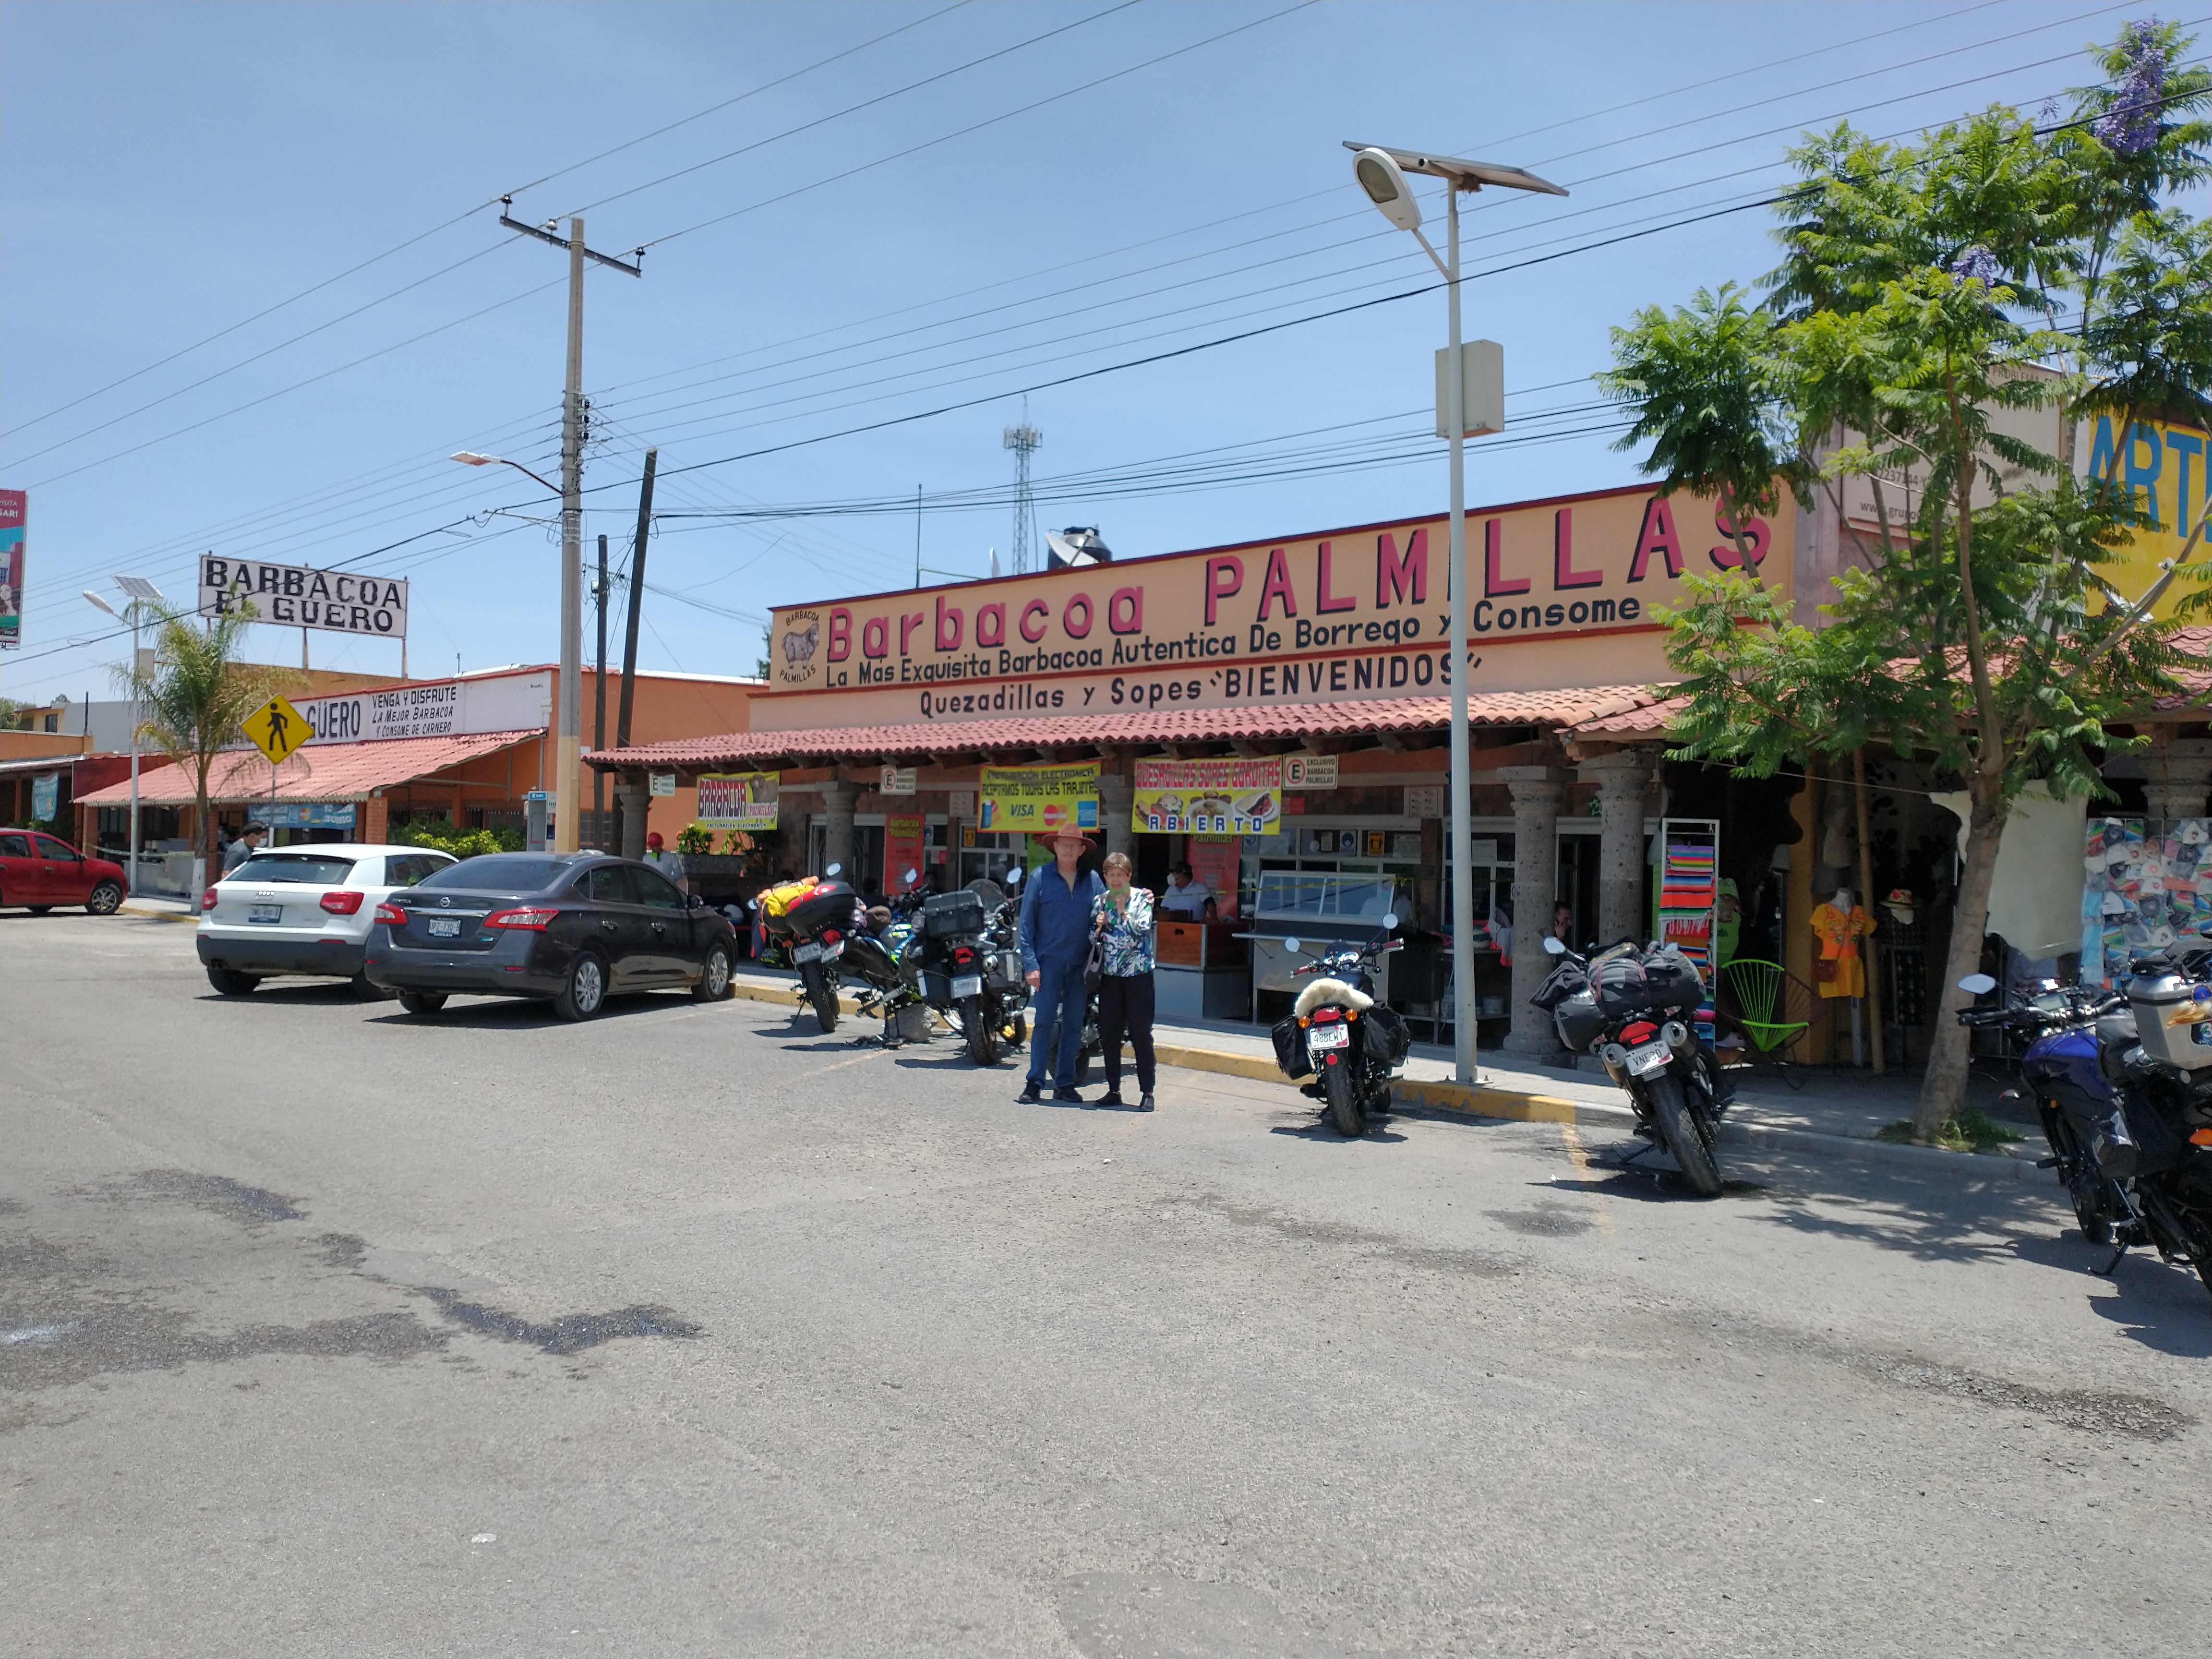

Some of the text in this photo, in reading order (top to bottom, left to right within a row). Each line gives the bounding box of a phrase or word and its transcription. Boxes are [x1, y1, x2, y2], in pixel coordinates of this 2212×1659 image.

[205, 559, 401, 609] BARBACOA
[827, 486, 1771, 663] Barbacoa PALMLLAS
[272, 597, 393, 632] GUERO
[786, 610, 819, 626] BARBACOA
[826, 666, 847, 687] La
[901, 653, 991, 683] Exquisita
[999, 647, 1103, 674] Barbacoa
[1112, 632, 1236, 665] Autentica
[1249, 624, 1282, 652] De
[1474, 596, 1640, 632] Consome
[780, 663, 816, 684] PALMILLAS
[372, 686, 457, 709] VENGA Y DISFRUTE
[920, 683, 1065, 720] Quezadillas
[1110, 677, 1202, 709] Sopes
[307, 701, 360, 738] GÜERO
[372, 706, 453, 724] LA MEJOR BARBACOA
[382, 724, 409, 738] CONSOME
[412, 723, 420, 734] DE
[422, 721, 451, 735] CARNERO
[1136, 758, 1281, 789] QUESADILLAS SOPES GORDITAS
[1010, 804, 1035, 817] VISA
[1149, 815, 1264, 832] ABIERTO
